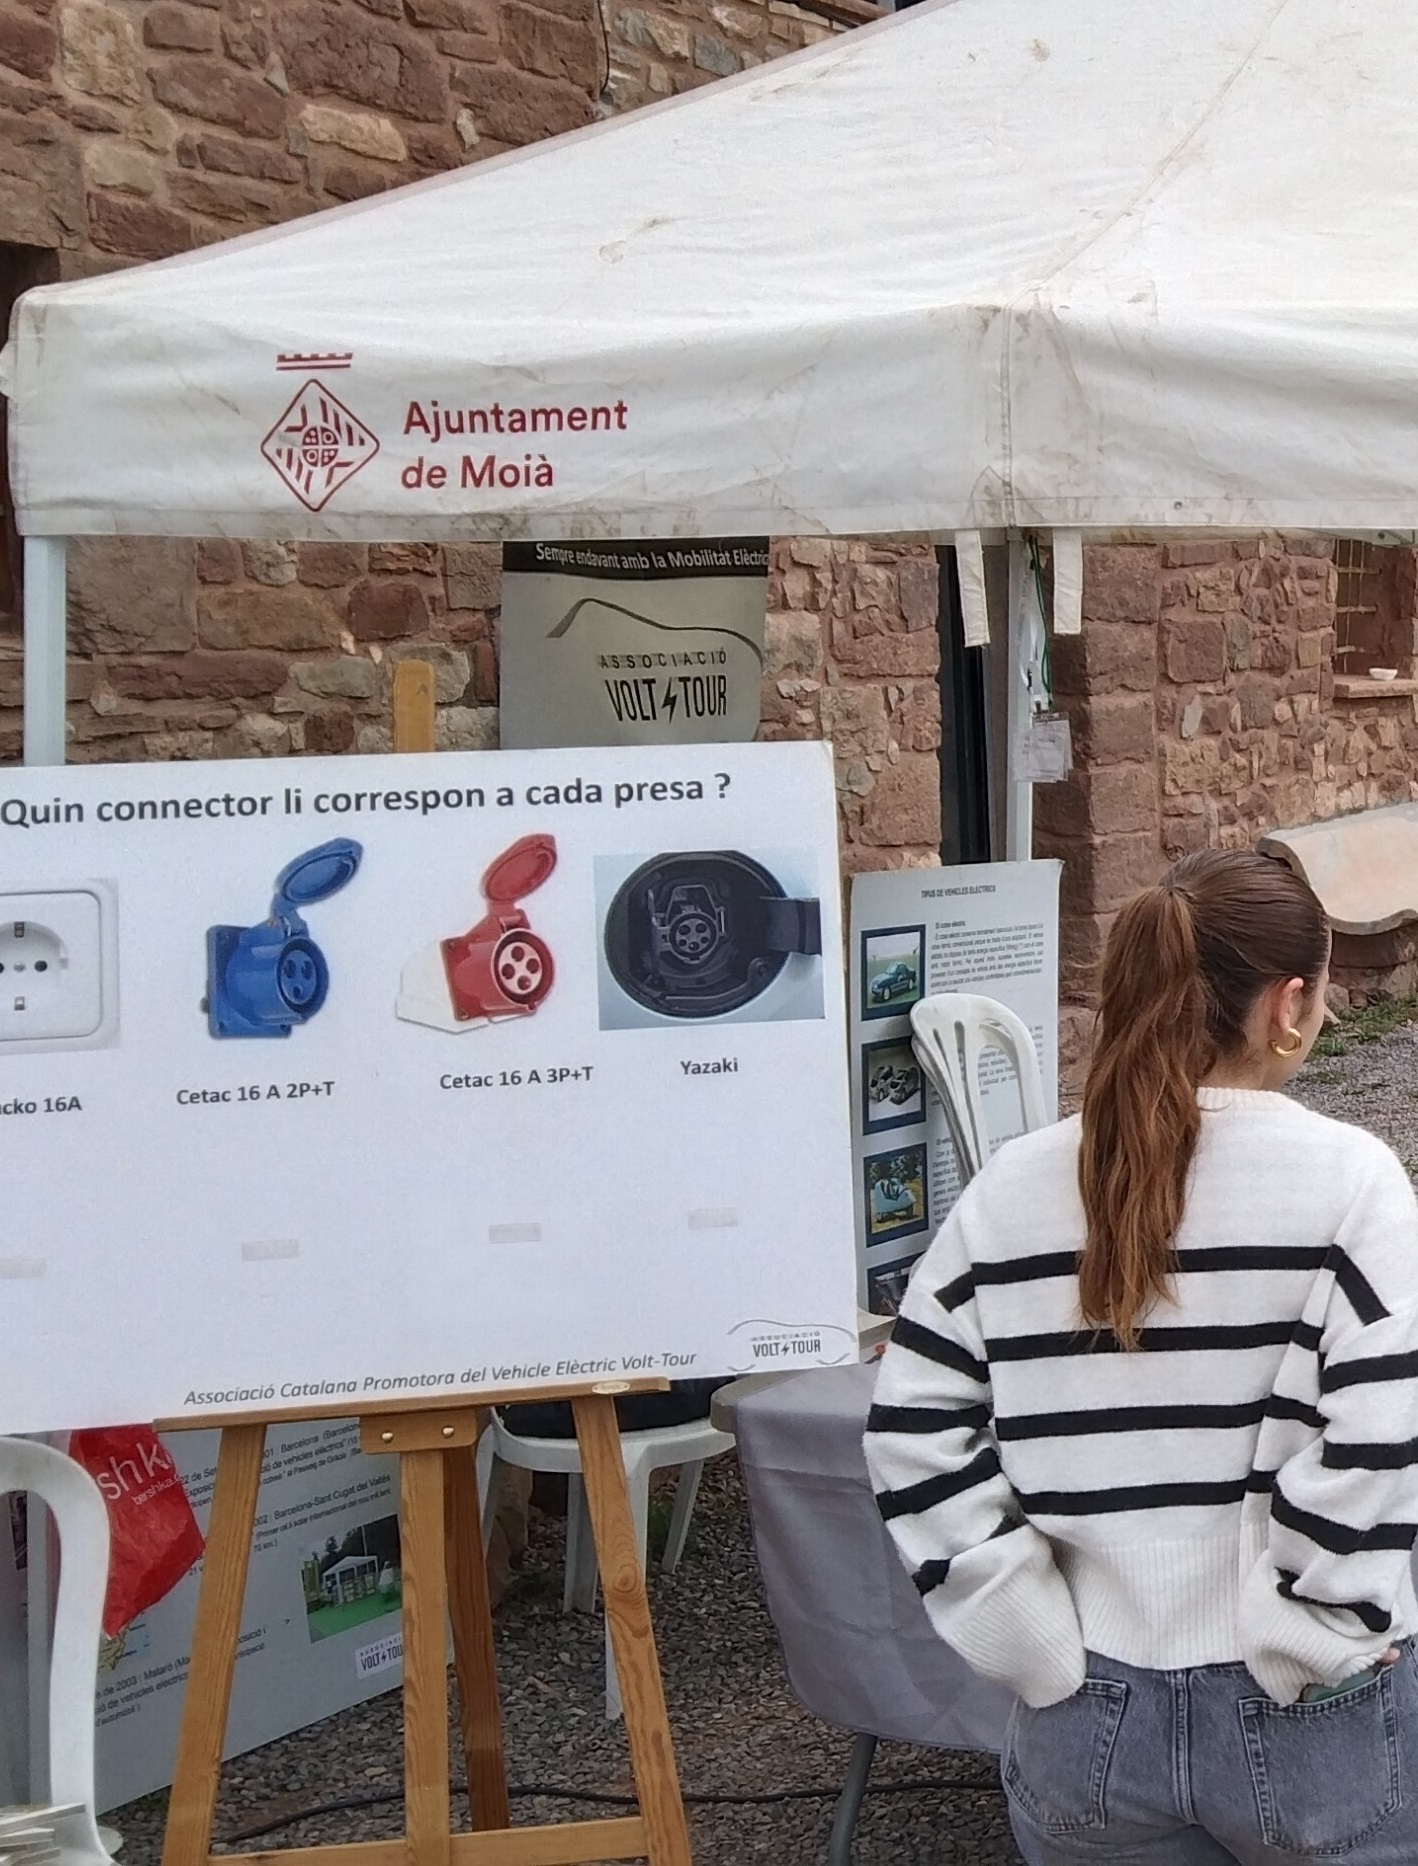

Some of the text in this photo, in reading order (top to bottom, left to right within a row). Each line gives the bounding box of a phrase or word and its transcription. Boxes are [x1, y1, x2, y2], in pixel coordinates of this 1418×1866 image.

[403, 400, 628, 442] Ajuntament
[401, 453, 553, 488] de Moià
[536, 543, 575, 566] Sempre
[576, 549, 620, 569] endavant
[621, 552, 649, 569] amb
[650, 551, 667, 568] la
[667, 549, 732, 567] Mobilitat
[600, 647, 726, 669] ASSOCIACIÓ
[604, 675, 727, 721] VOLT TOUR
[0, 772, 731, 828] Quin connector li correspon a cada presa ?
[440, 1066, 594, 1090] Cetac 16 A 3P+T
[680, 1057, 739, 1075] Yazaki
[43, 1096, 82, 1113] 16A
[176, 1081, 335, 1105] Cetac 16 A 2P+T
[753, 1339, 821, 1357] VOLT TOUR
[184, 1351, 697, 1406] Associació Catalana Promotora del Vehicle Elèctric Volt-Tour
[281, 1435, 319, 1454] Barcelona
[96, 1442, 172, 1500] shk
[333, 1486, 355, 1498] Cugat
[360, 1644, 403, 1671] VOLT TOU
